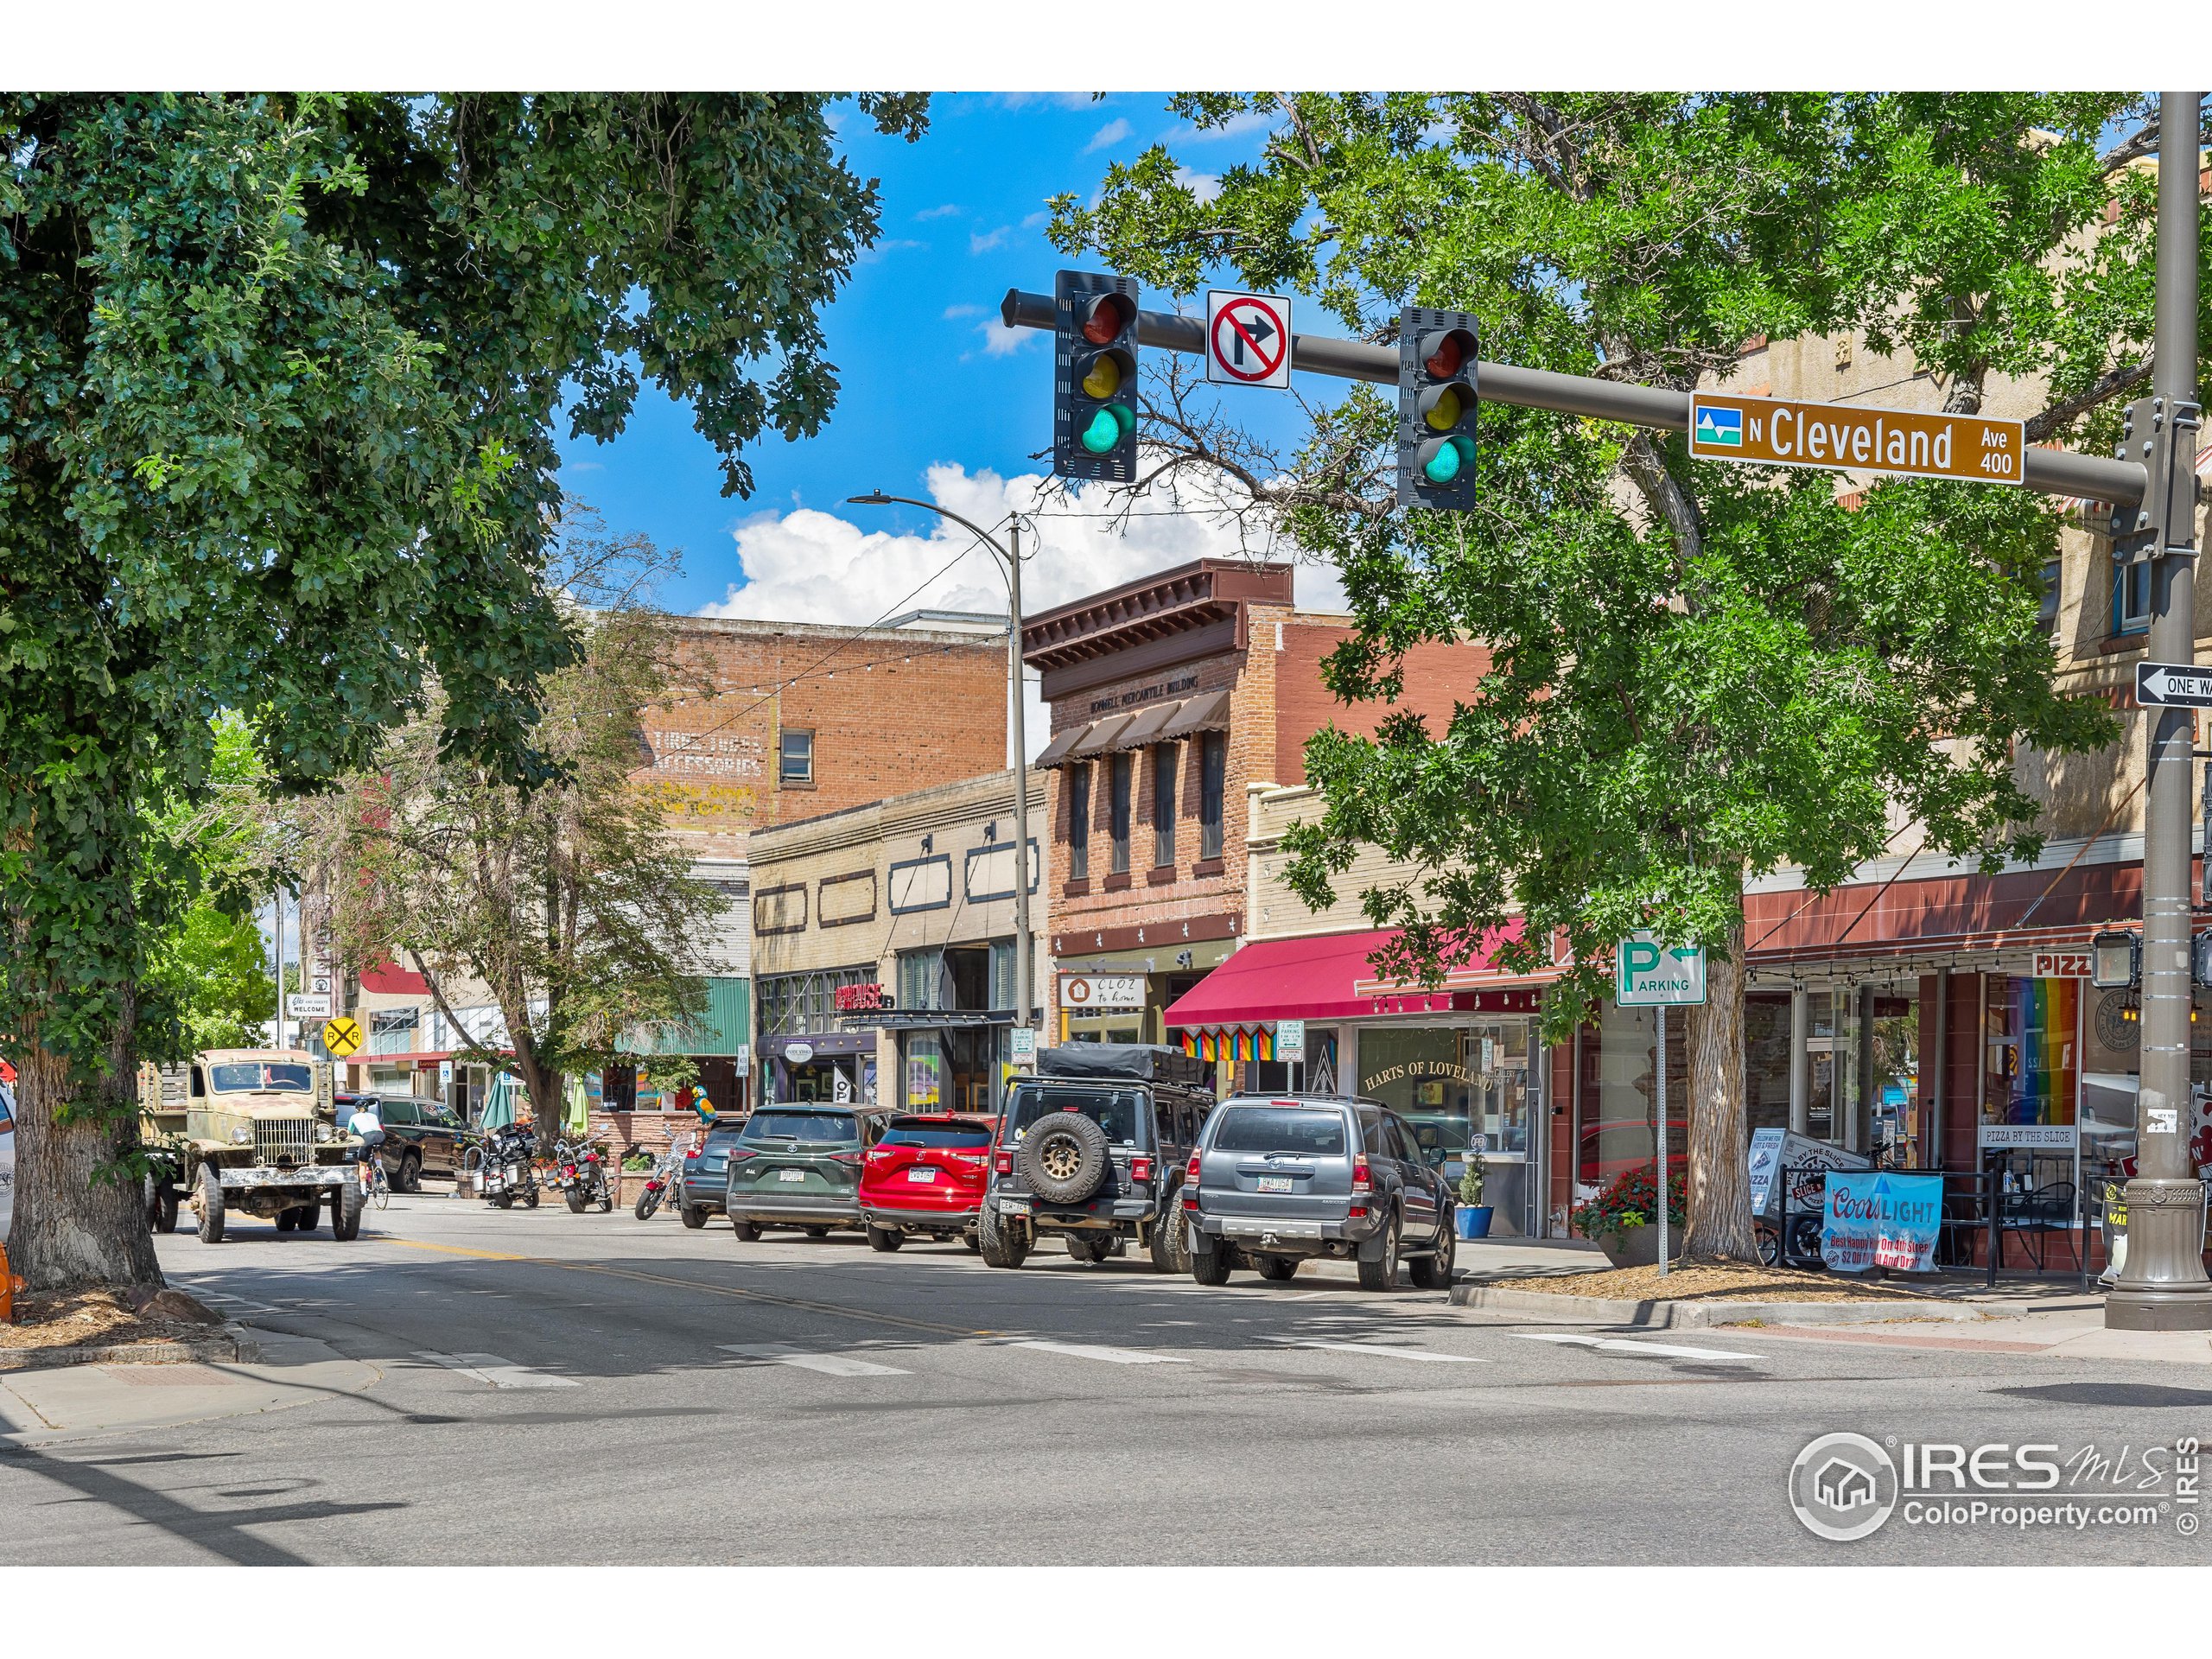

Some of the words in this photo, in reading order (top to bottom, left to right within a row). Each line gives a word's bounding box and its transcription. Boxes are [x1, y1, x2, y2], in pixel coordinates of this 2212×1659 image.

[1749, 418, 1762, 442] N
[1770, 407, 1953, 469] Cleveland
[1980, 427, 2008, 448] Ave
[1980, 453, 2013, 474] 400
[1122, 684, 1164, 706] MERCANTILE
[1166, 676, 1198, 695] BUILDING
[2167, 677, 2195, 694] ONE
[2037, 955, 2092, 976] PIZZ
[1112, 991, 1136, 1002] home
[327, 1032, 335, 1041] R
[352, 1032, 359, 1041] R
[1365, 1065, 1404, 1091] HARTS
[1408, 1062, 1425, 1075] OF
[1428, 1061, 1494, 1092] LOVELAND
[1986, 1131, 2010, 1141] PIZZA
[2013, 1131, 2023, 1141] BY
[2025, 1131, 2042, 1141] THE
[2044, 1131, 2070, 1142] SLICE
[1797, 1152, 1808, 1162] BY
[1824, 1149, 1845, 1169] SLICE
[1750, 1175, 1769, 1185] IZZA
[1795, 1184, 1816, 1198] SLICE
[1832, 1186, 1881, 1220] Coors
[1881, 1199, 1935, 1224] LIGHT
[2108, 1211, 2127, 1225] MAR
[1831, 1236, 1846, 1248] Best
[1847, 1236, 1869, 1250] Happy
[1881, 1238, 1892, 1250] On
[1894, 1239, 1905, 1252] 4th
[1841, 1250, 1851, 1264] $2
[1852, 1251, 1861, 1264] Off
[1884, 1254, 1899, 1268] And
